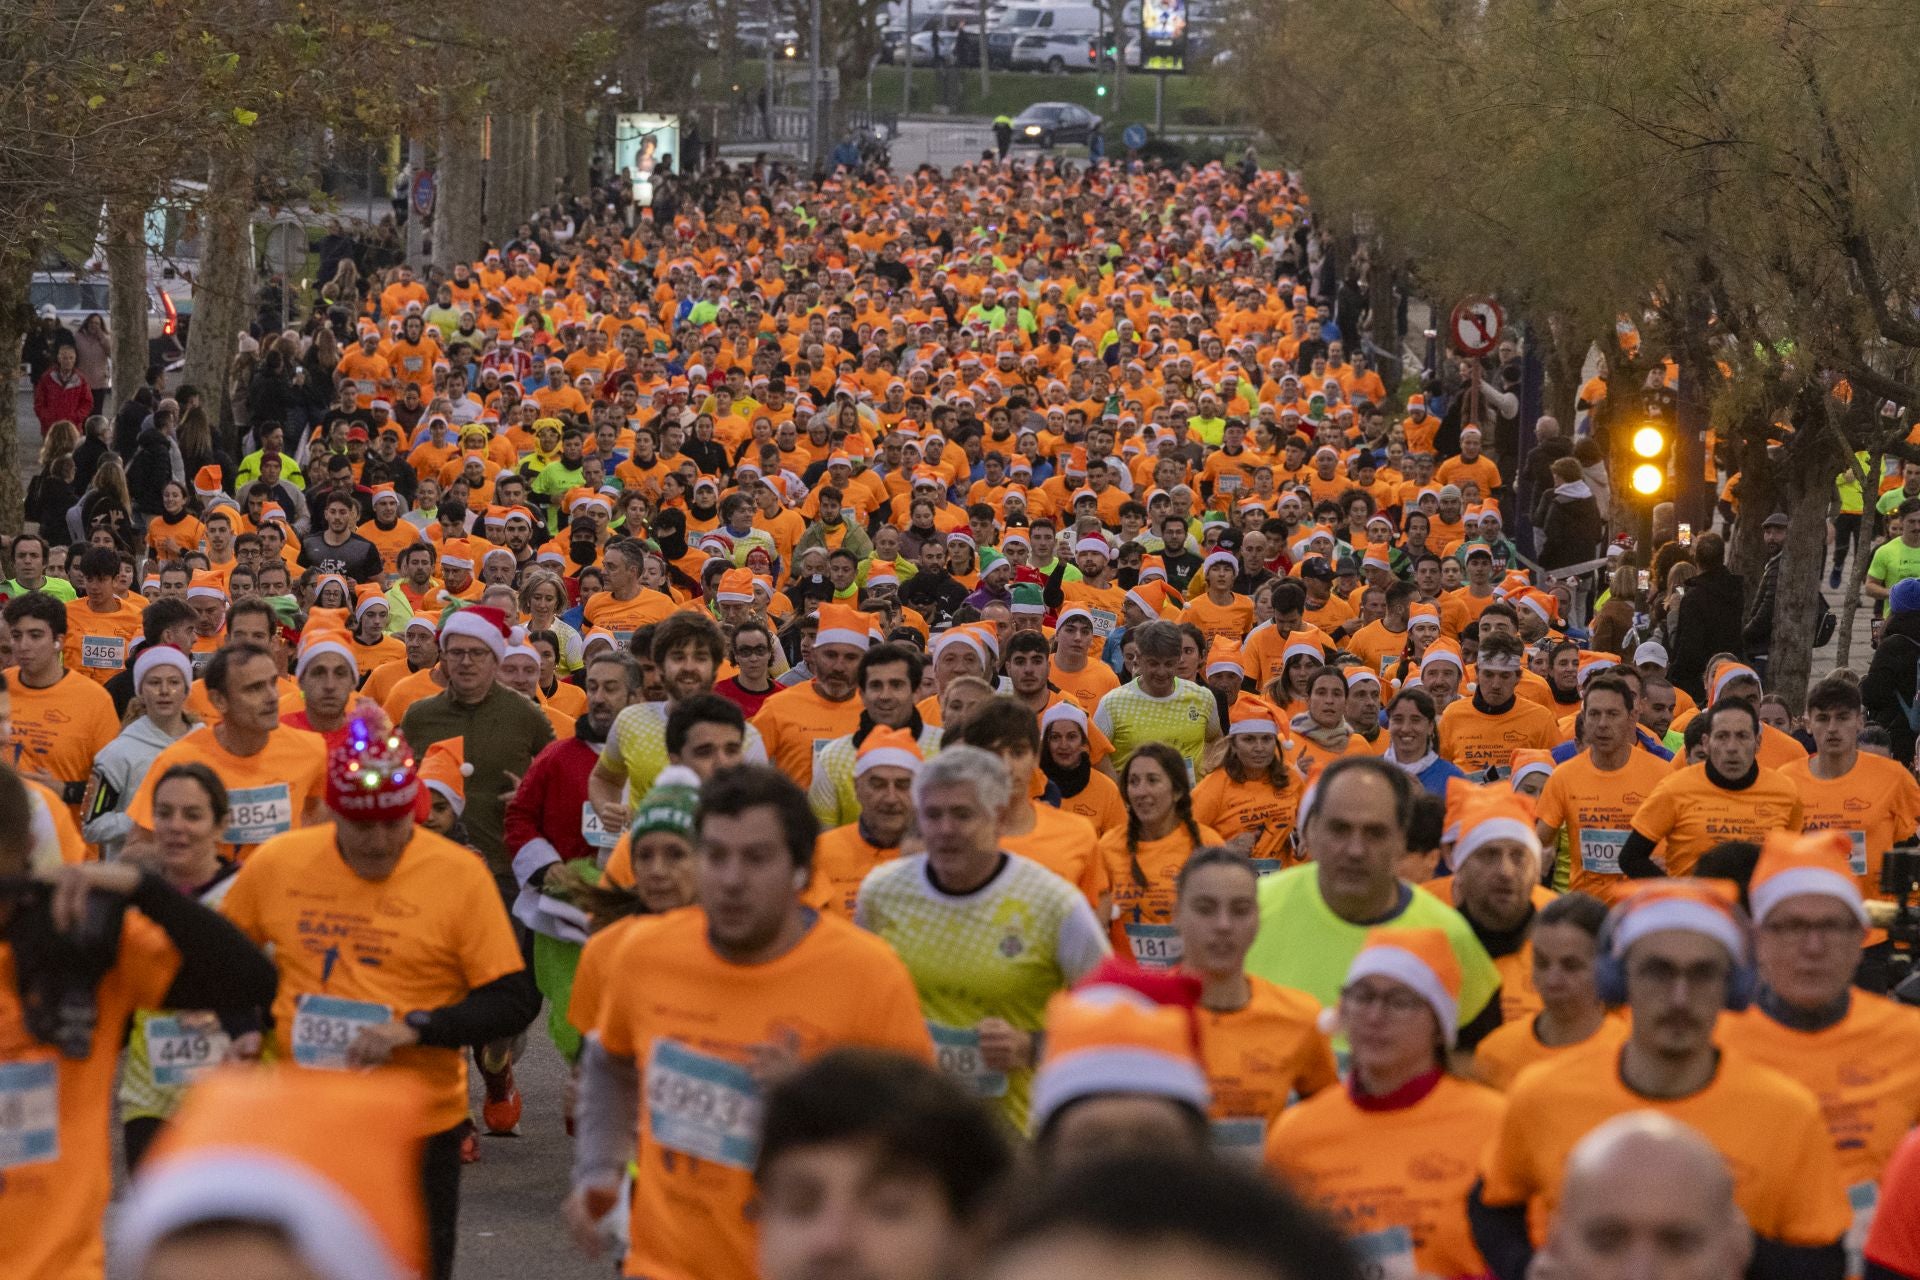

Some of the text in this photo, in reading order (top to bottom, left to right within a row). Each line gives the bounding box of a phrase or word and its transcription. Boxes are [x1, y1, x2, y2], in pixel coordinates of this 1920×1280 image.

[84, 645, 116, 659] 3456
[1465, 751, 1493, 759] SAN
[1240, 811, 1269, 823] SAN
[1579, 814, 1610, 822] SAN
[1706, 824, 1742, 834] SAN
[1136, 938, 1166, 957] 181
[299, 1016, 350, 1046] 393
[160, 1038, 211, 1061] 449
